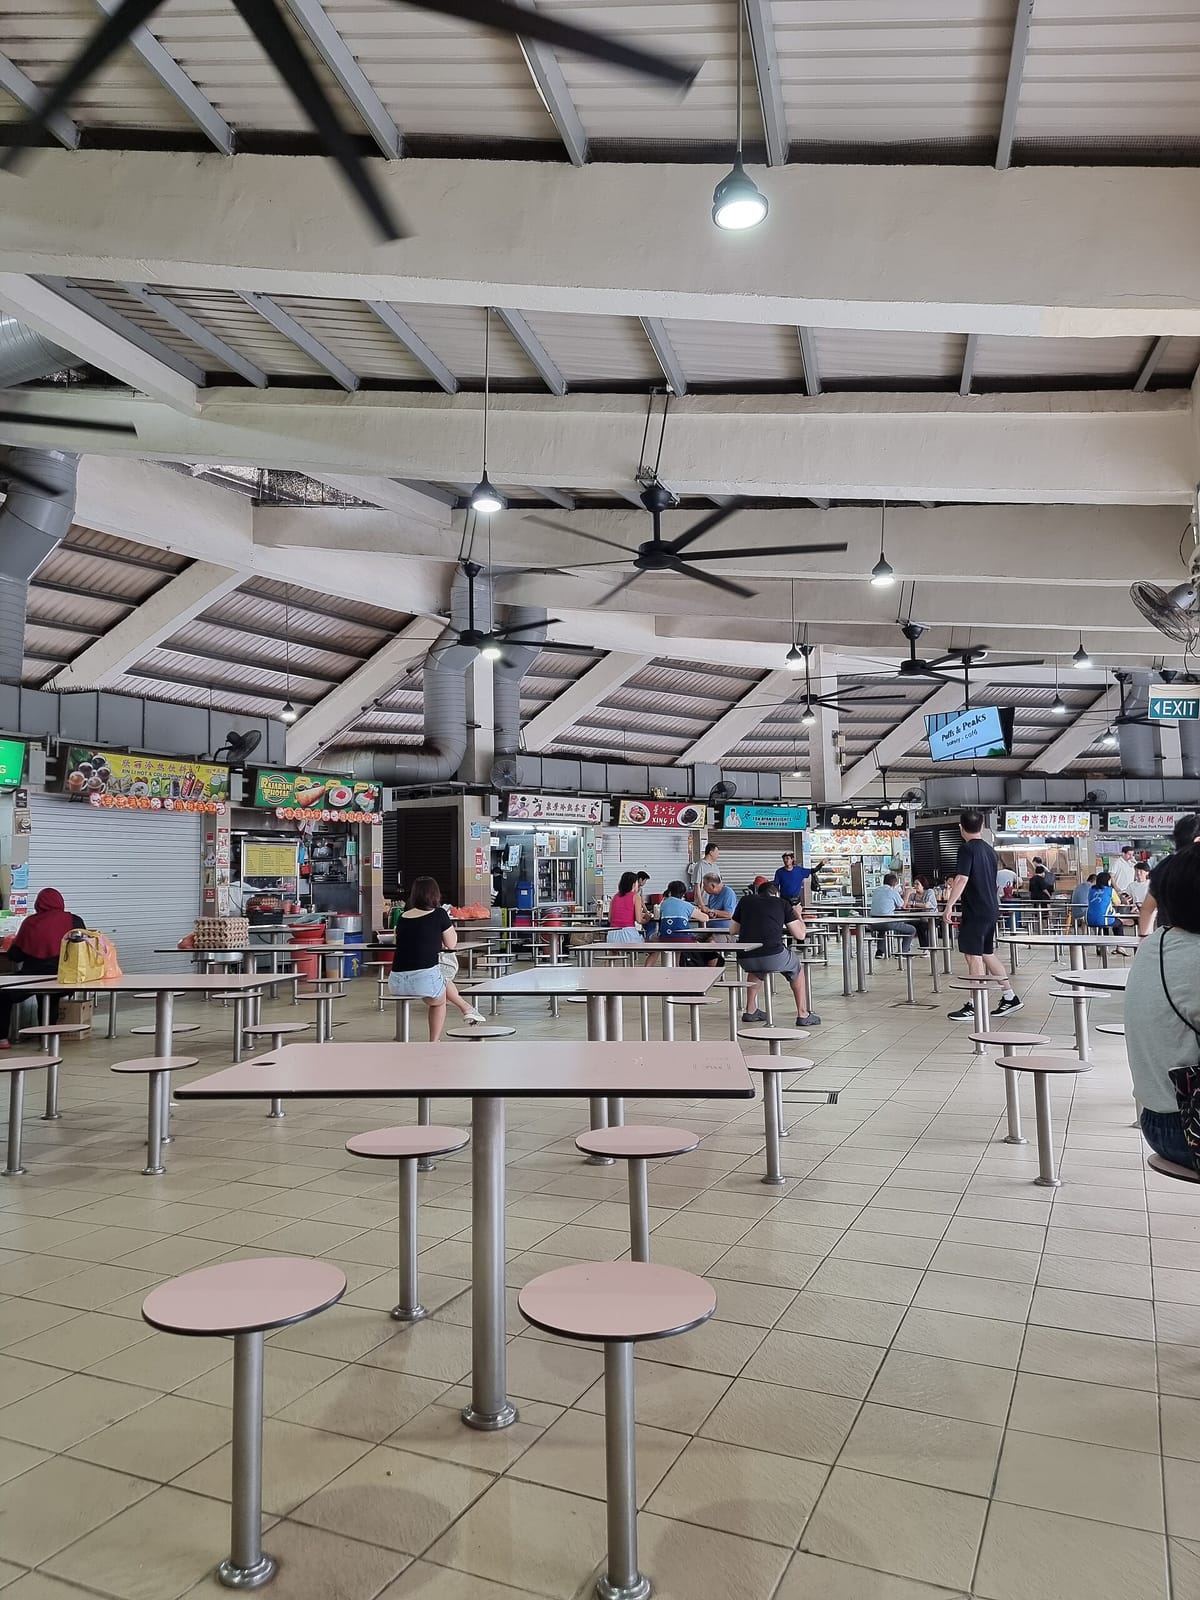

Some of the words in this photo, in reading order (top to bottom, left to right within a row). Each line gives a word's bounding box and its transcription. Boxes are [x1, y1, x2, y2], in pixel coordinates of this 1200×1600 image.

[1162, 701, 1196, 715] EXIT
[942, 730, 954, 741] Puffs
[956, 726, 961, 734] &
[962, 714, 987, 730] Peaks
